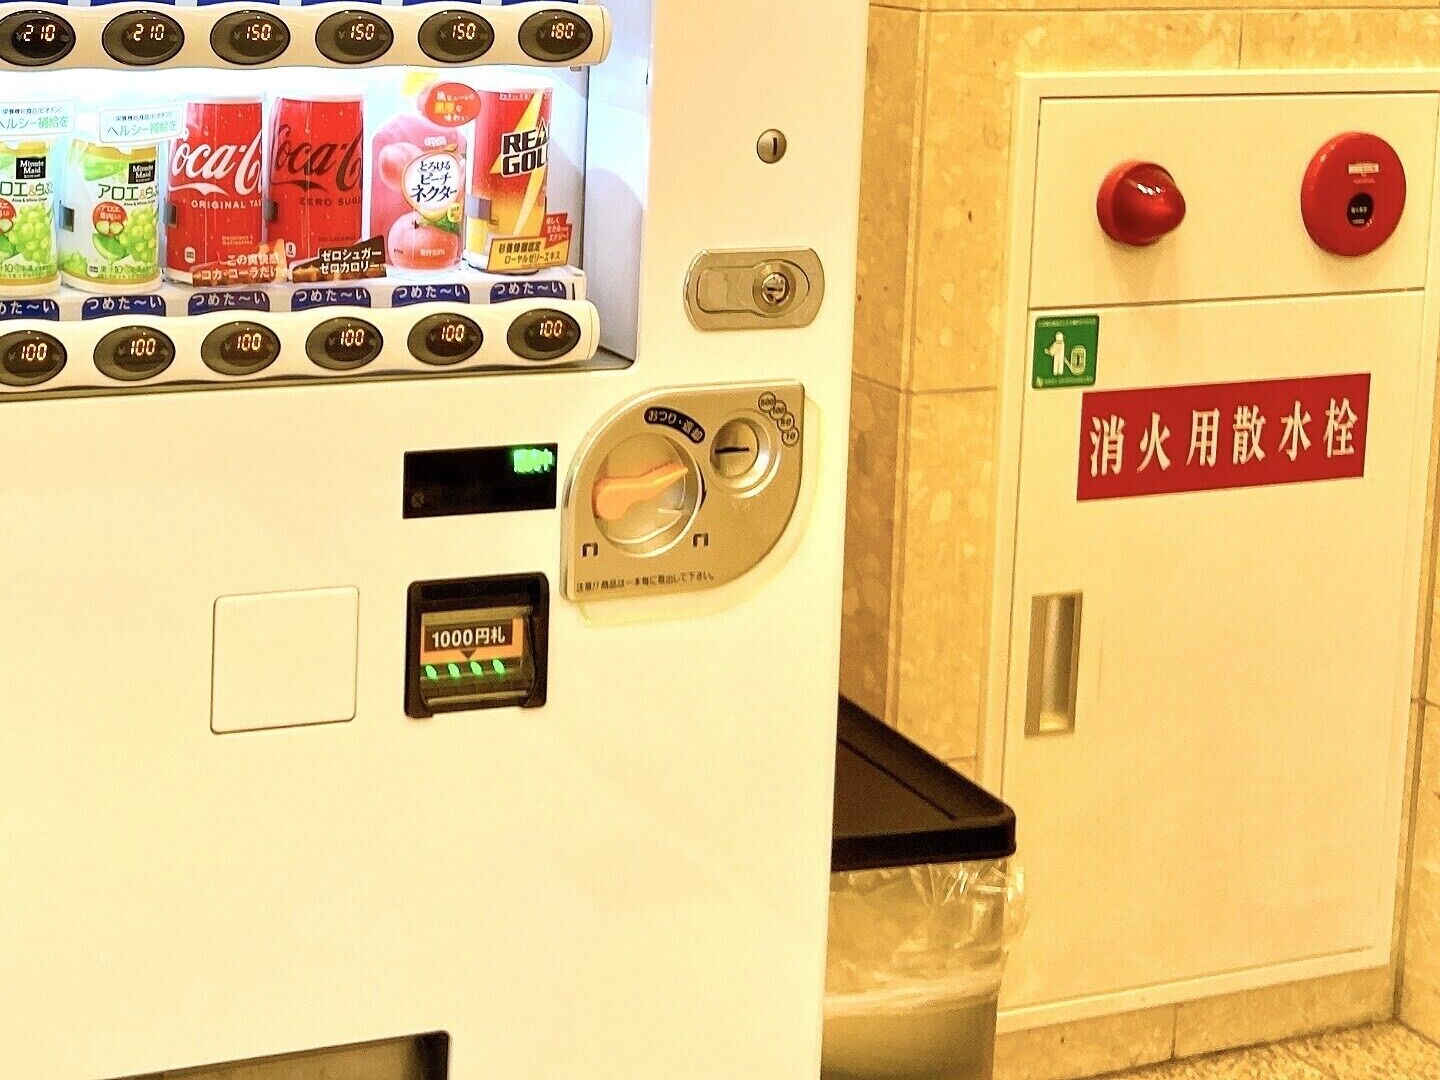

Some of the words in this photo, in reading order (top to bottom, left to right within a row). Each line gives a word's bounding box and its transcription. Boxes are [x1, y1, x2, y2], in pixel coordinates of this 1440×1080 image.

[22, 24, 55, 41] 210
[132, 24, 165, 41] 210
[246, 24, 271, 41] 150
[350, 24, 375, 40] 150
[452, 23, 477, 39] 150
[550, 23, 575, 39] 180
[20, 160, 44, 169] Minute
[420, 172, 452, 185] ピーチ
[410, 185, 458, 203] ネクター
[321, 248, 383, 261] ゼロシュガー
[319, 261, 383, 275] ゼロカロリー
[441, 325, 465, 343] 100
[539, 320, 563, 338] 100
[237, 334, 262, 352] 100
[340, 329, 365, 347] 100
[21, 343, 48, 362] 100
[130, 338, 156, 357] 100
[1089, 396, 1359, 478] 消火用散水栓
[431, 627, 506, 648] 1000円札
